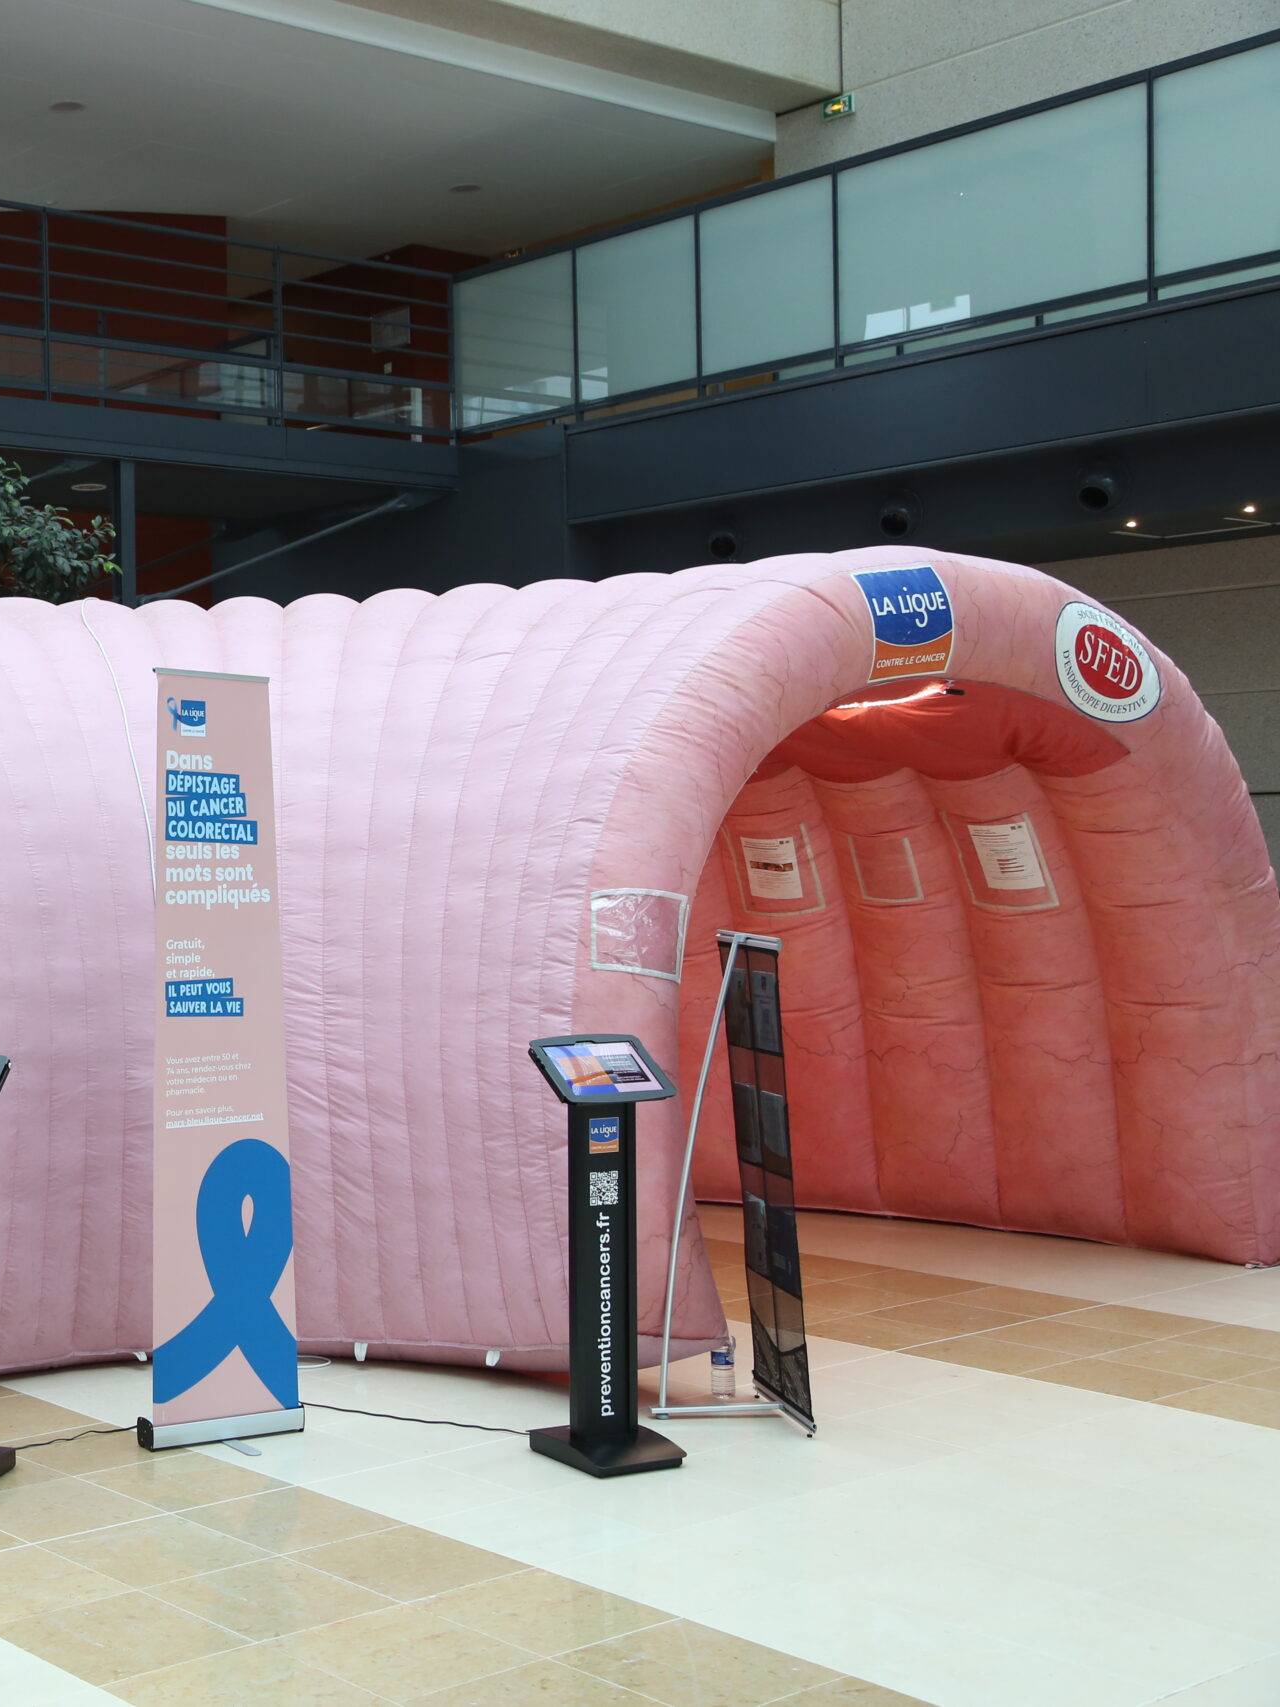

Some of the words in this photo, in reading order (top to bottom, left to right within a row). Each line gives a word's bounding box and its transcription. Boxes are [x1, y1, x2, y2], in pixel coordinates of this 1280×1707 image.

[872, 597, 896, 616] LA
[877, 658, 904, 668] CONTRE
[905, 657, 914, 665] LE
[916, 653, 946, 663] CANCER
[1079, 632, 1138, 690] SFED
[1063, 650, 1100, 709] D'ENDOSCOPIE
[1100, 695, 1147, 714] DIGESTIVE
[166, 750, 212, 770] Dans
[168, 772, 236, 794] DÉPISTAGE
[168, 801, 185, 817] DU
[190, 797, 244, 816] CANCER
[168, 821, 254, 842] COLORECTAL
[166, 843, 212, 859] seuls
[216, 843, 239, 859] les
[166, 864, 211, 882] mots
[216, 864, 253, 881] sont
[165, 884, 270, 909] compliqués
[166, 939, 204, 950] Gratuit,
[166, 953, 200, 966] simple
[166, 969, 176, 978] et
[180, 967, 215, 980] rapide,
[169, 985, 176, 998] IL
[180, 983, 202, 996] PEUT
[206, 982, 230, 994] VOUS
[170, 1001, 207, 1014] SAUVER
[211, 1001, 223, 1013] LA
[226, 1001, 241, 1013] VIE
[202, 1054, 220, 1062] entre
[192, 1064, 233, 1073] rendez-vous
[186, 1074, 216, 1084] médecin
[166, 1109, 183, 1117] Pour
[196, 1106, 216, 1114] savoir
[596, 1212, 614, 1416] preventioncancers.fr
